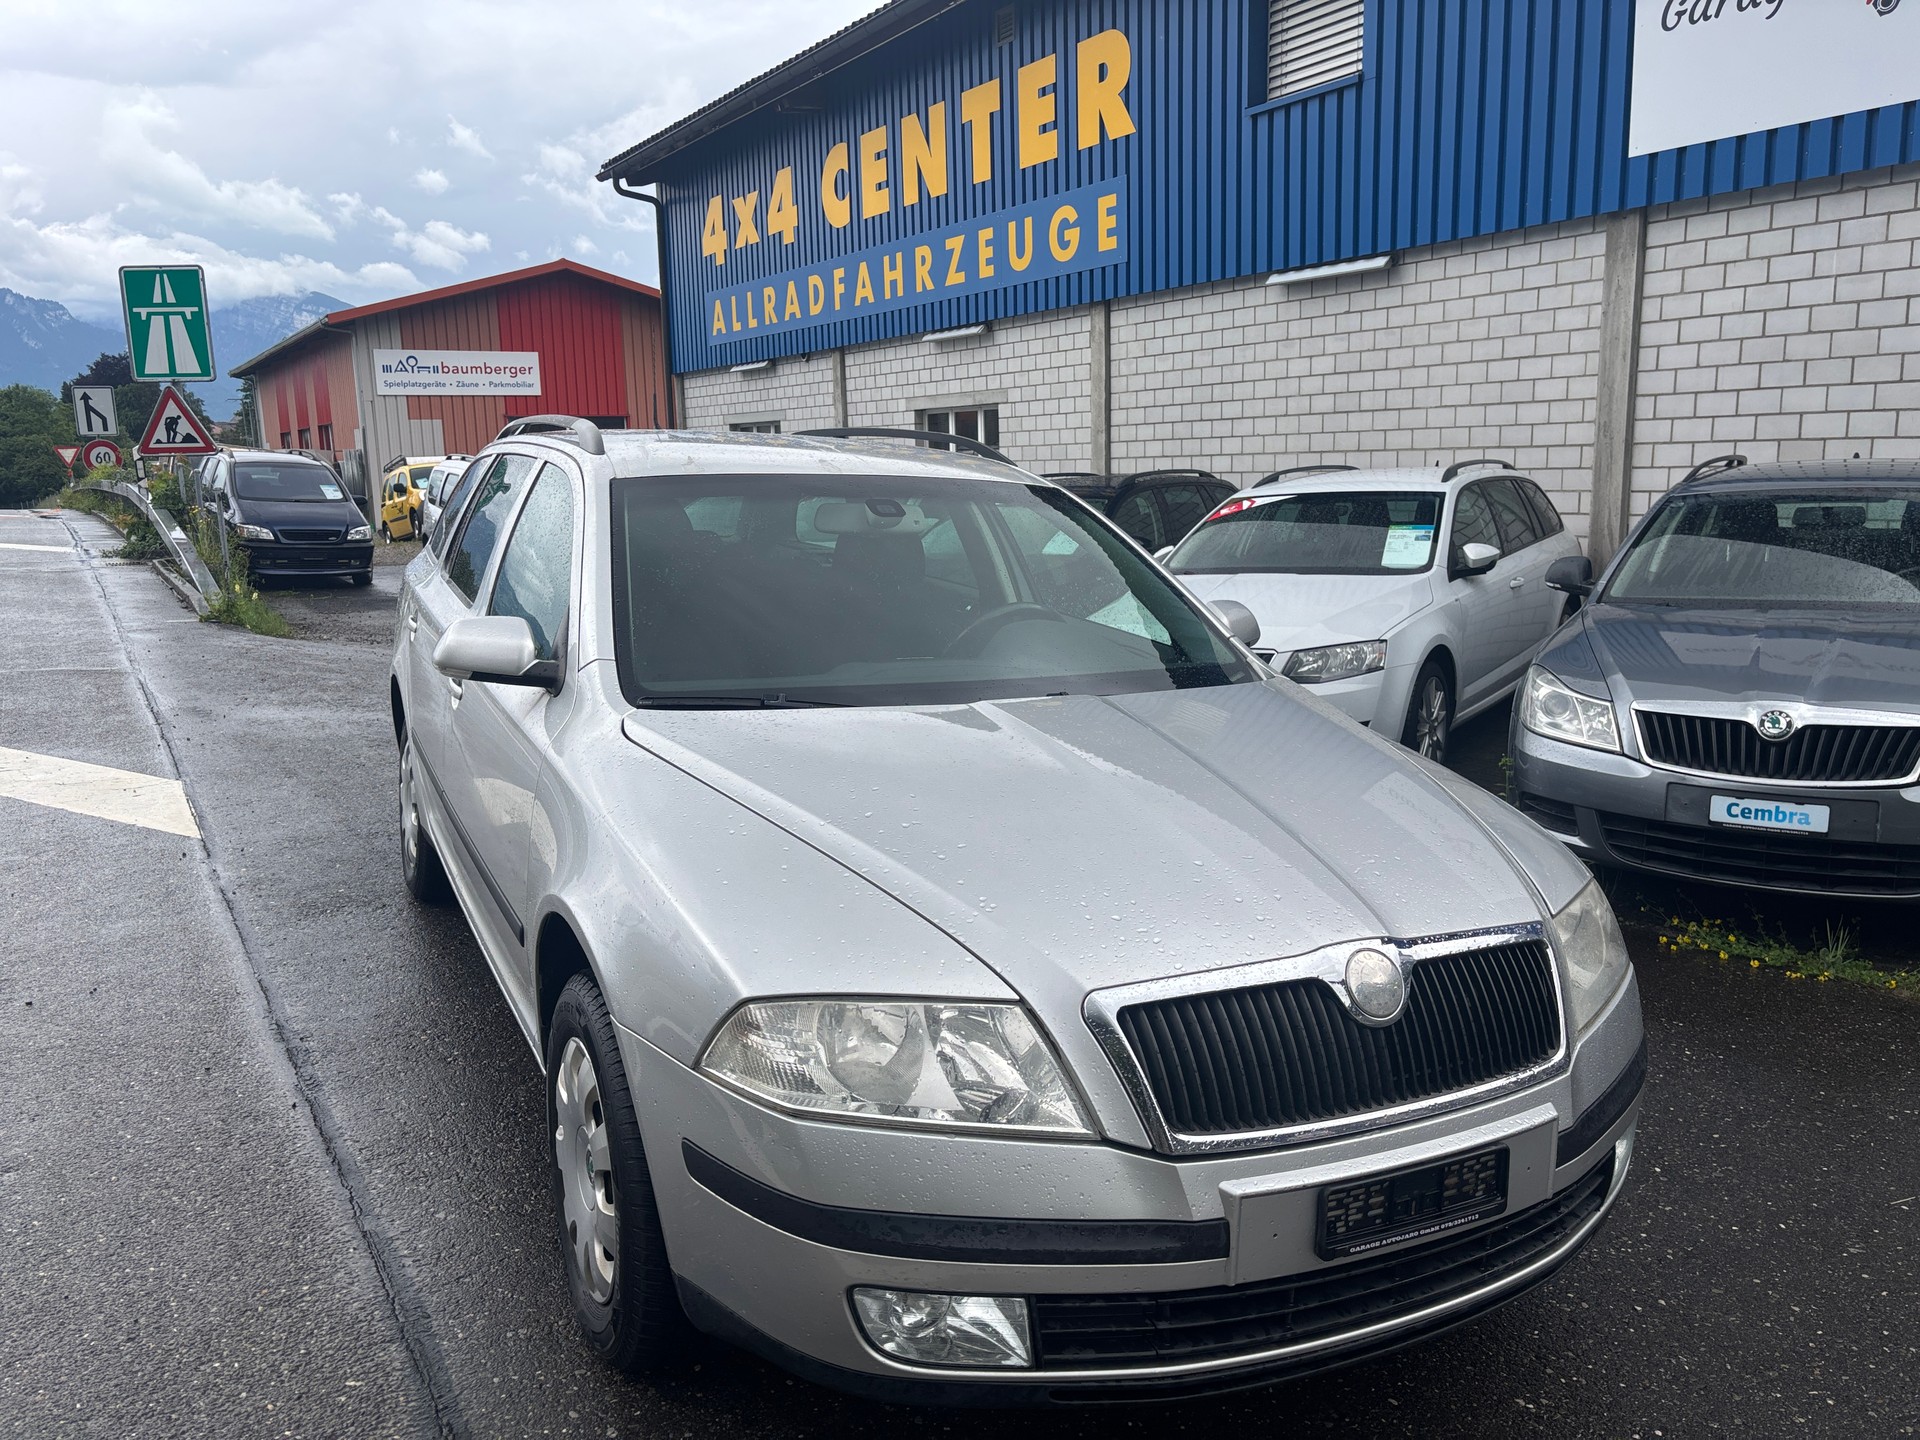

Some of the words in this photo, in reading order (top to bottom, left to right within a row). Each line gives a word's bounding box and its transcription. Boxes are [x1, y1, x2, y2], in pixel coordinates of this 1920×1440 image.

[703, 165, 798, 267] 4x4
[821, 28, 1136, 229] CENTER
[712, 193, 1118, 336] ALLRADFAHRZEUGE
[440, 361, 533, 378] baumberger
[383, 380, 446, 389] Spielplatzgeräte
[456, 380, 479, 388] Zäune
[488, 380, 535, 388] Parkmobiliar
[95, 451, 111, 464] 60
[1726, 802, 1811, 826] Cembra
[1350, 1241, 1380, 1252] GARAGE
